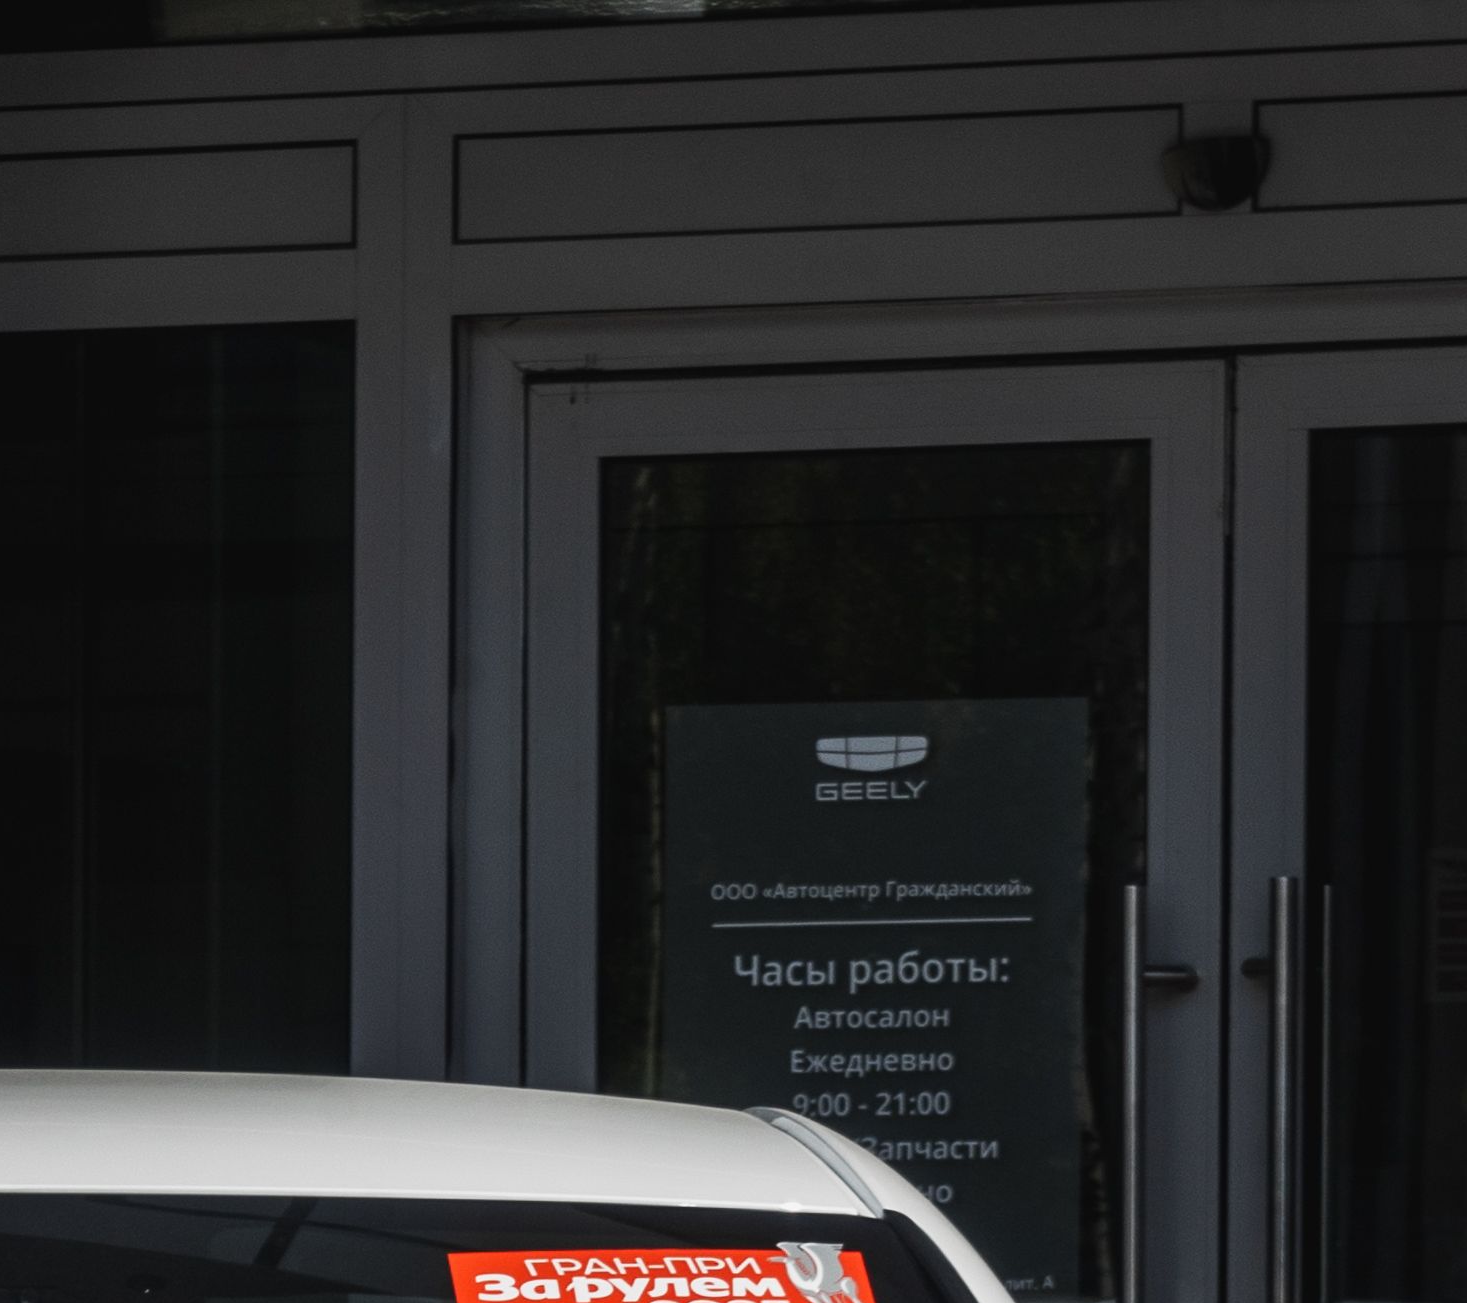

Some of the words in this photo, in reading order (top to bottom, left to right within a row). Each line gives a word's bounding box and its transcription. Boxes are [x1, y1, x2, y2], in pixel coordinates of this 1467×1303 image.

[814, 780, 928, 802] GEELY
[710, 882, 758, 901] ООО
[763, 880, 881, 903] «Автоцентр
[885, 879, 1033, 901] Гражданский»
[734, 954, 836, 988] Часы
[848, 950, 1011, 995] работы:
[793, 1006, 951, 1030] Автосалон
[789, 1049, 955, 1078] Ежедневно
[792, 1094, 851, 1118] 9:00
[876, 1092, 952, 1117] 21:00
[523, 1256, 763, 1278] ГРАН-ПРИ
[474, 1273, 562, 1303] За
[565, 1275, 787, 1303] рулем
